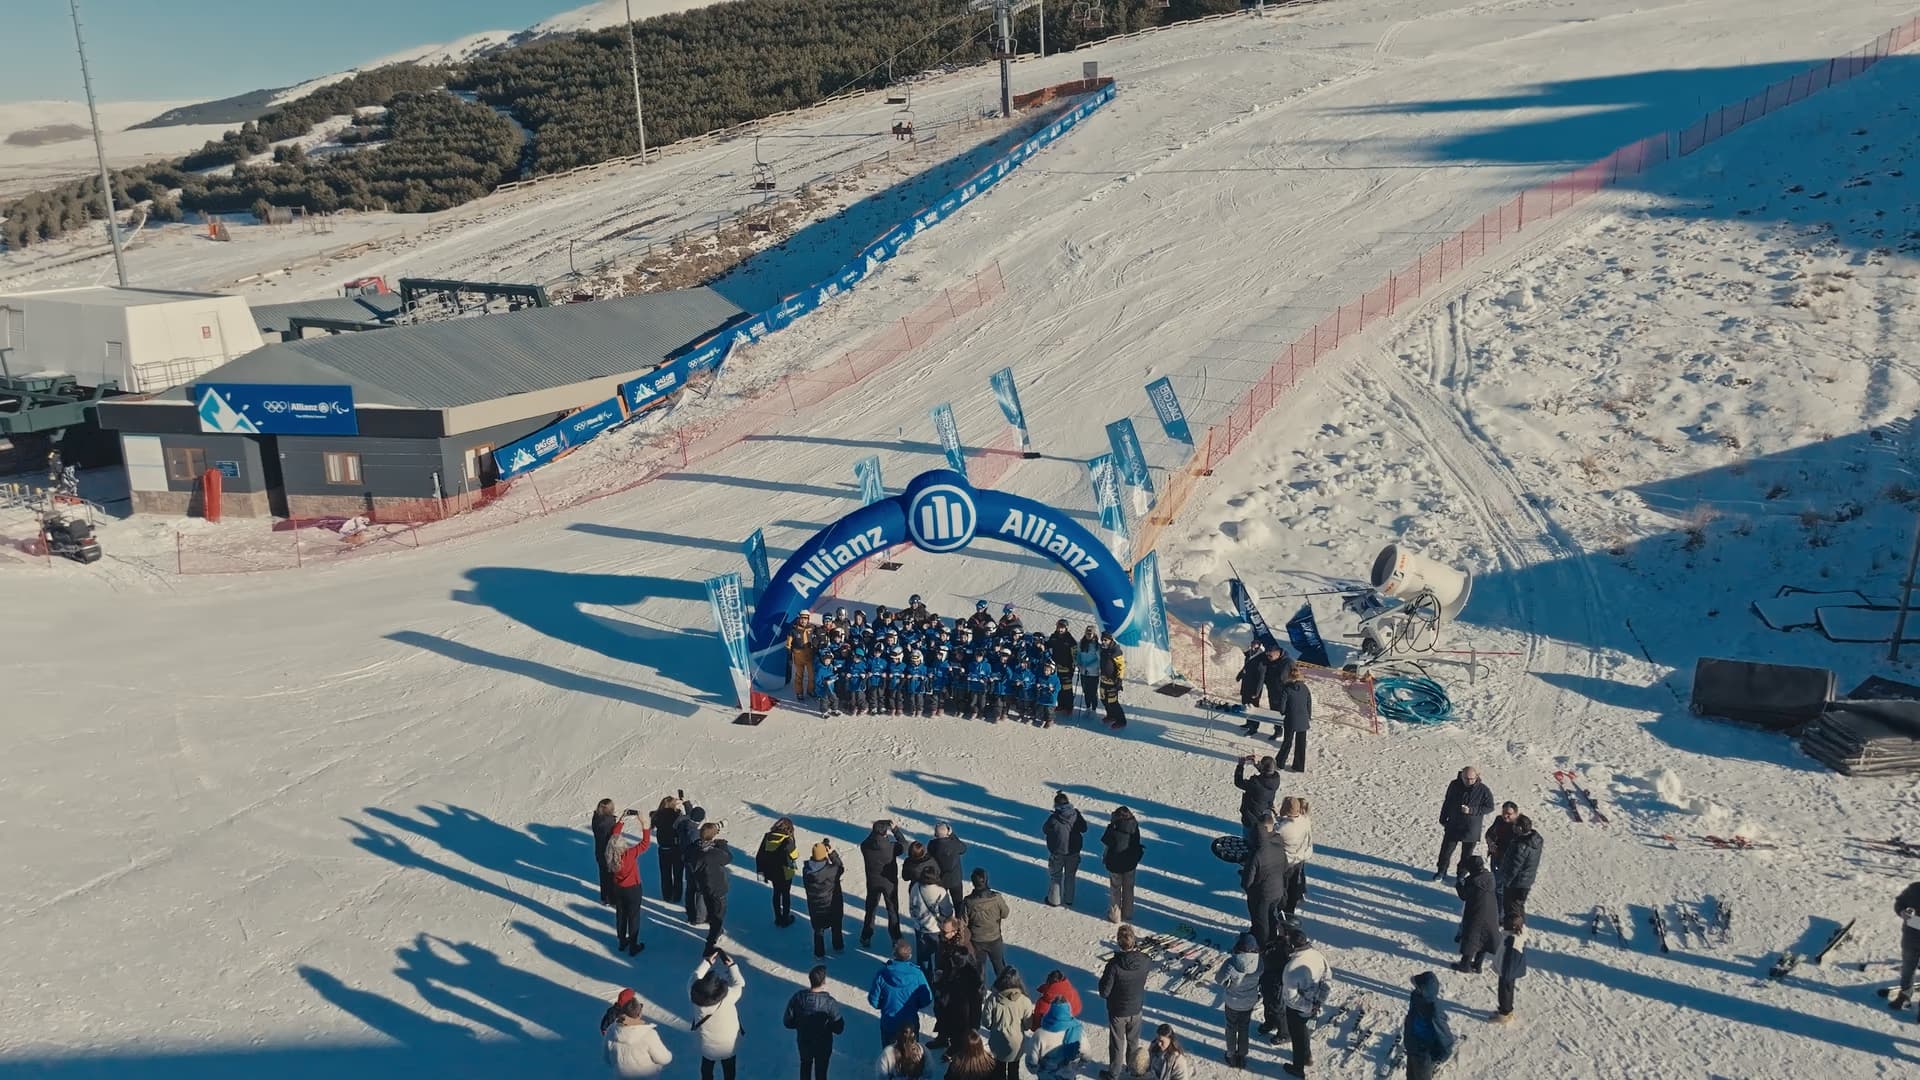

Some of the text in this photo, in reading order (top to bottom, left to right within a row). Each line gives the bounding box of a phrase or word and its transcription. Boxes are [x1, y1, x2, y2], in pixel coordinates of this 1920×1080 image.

[291, 402, 319, 411] Allianz
[788, 526, 888, 599] Allianz
[1000, 508, 1099, 577] Allianz
